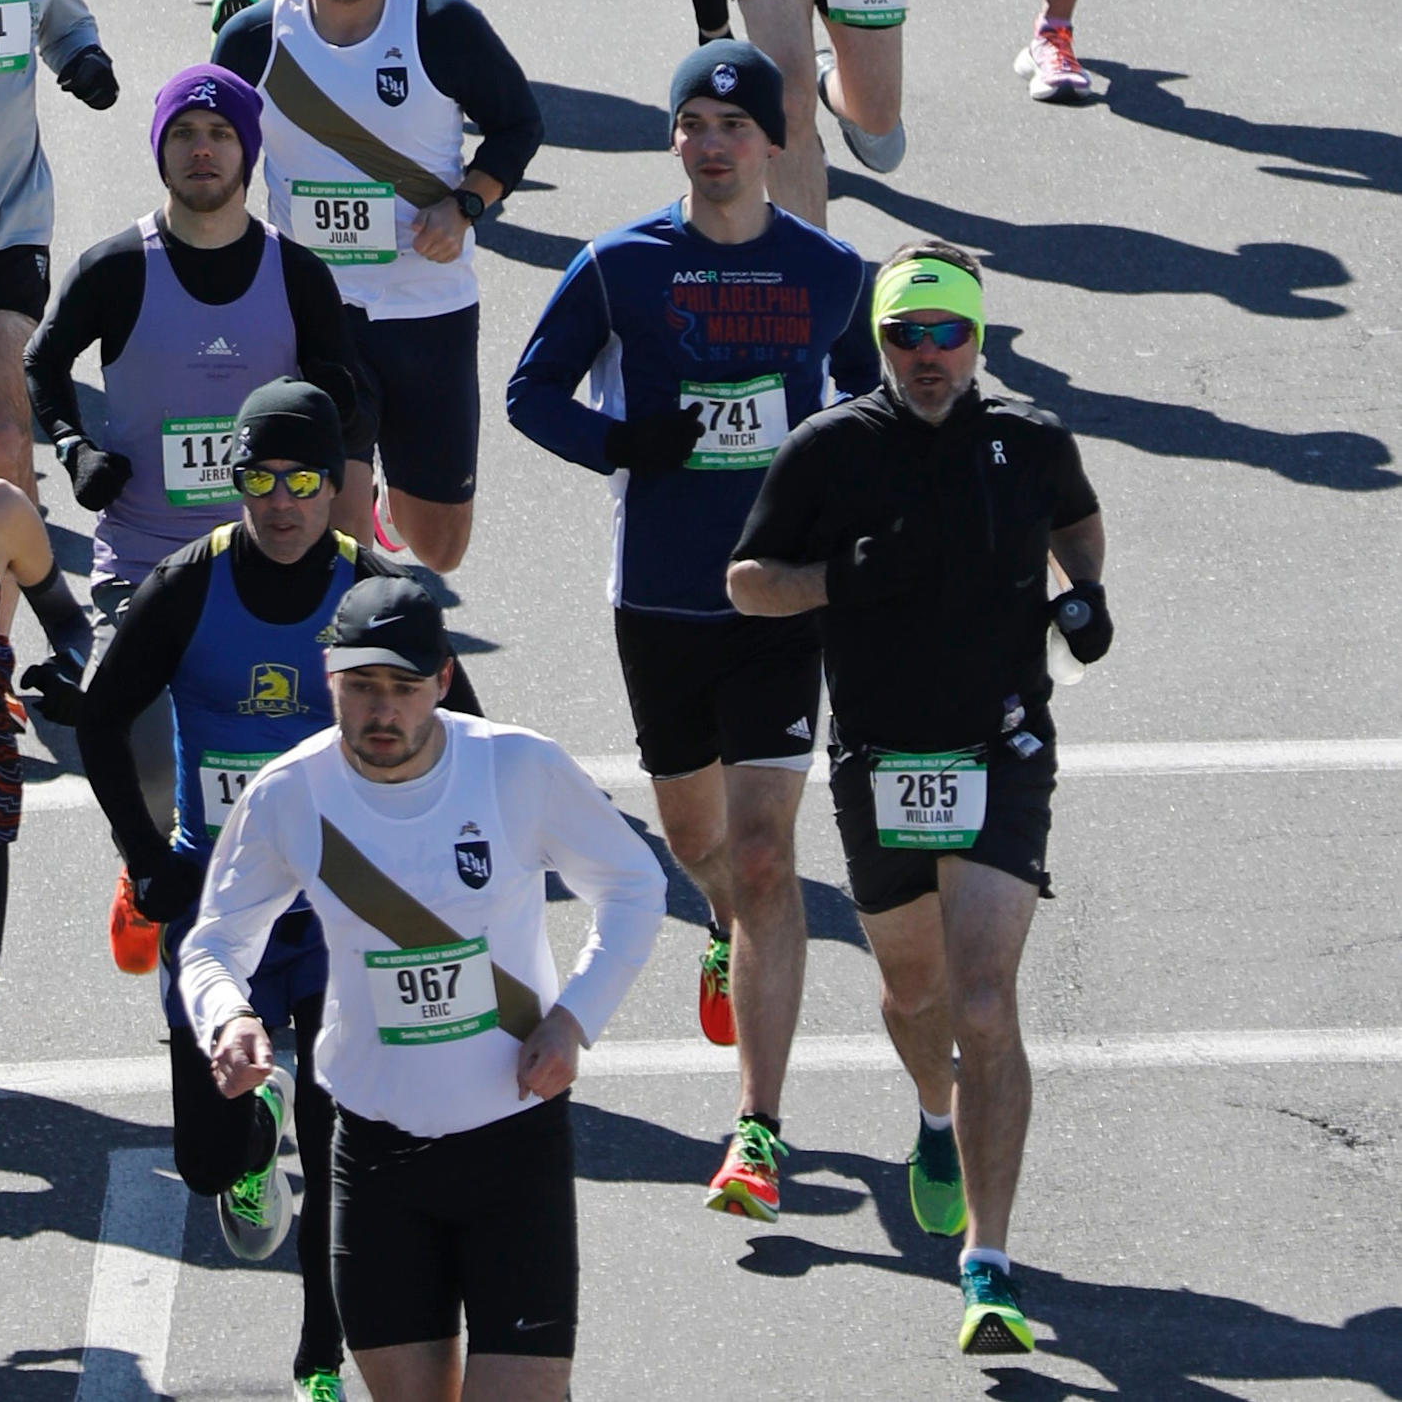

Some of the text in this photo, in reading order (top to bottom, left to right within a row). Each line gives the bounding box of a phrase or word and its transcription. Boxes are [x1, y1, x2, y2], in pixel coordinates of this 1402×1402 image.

[313, 199, 370, 232] 958
[327, 230, 358, 245] JUAN
[673, 270, 718, 285] AACR
[672, 286, 810, 313] PHILADELPHIA
[708, 316, 812, 345] MARATHON
[708, 396, 760, 432] 741
[180, 435, 235, 469] 112
[717, 430, 756, 447] MITCH
[894, 772, 959, 810] 265
[904, 808, 954, 824] WILLIAM
[395, 963, 461, 1005] 967
[420, 1003, 451, 1019] ERIC
